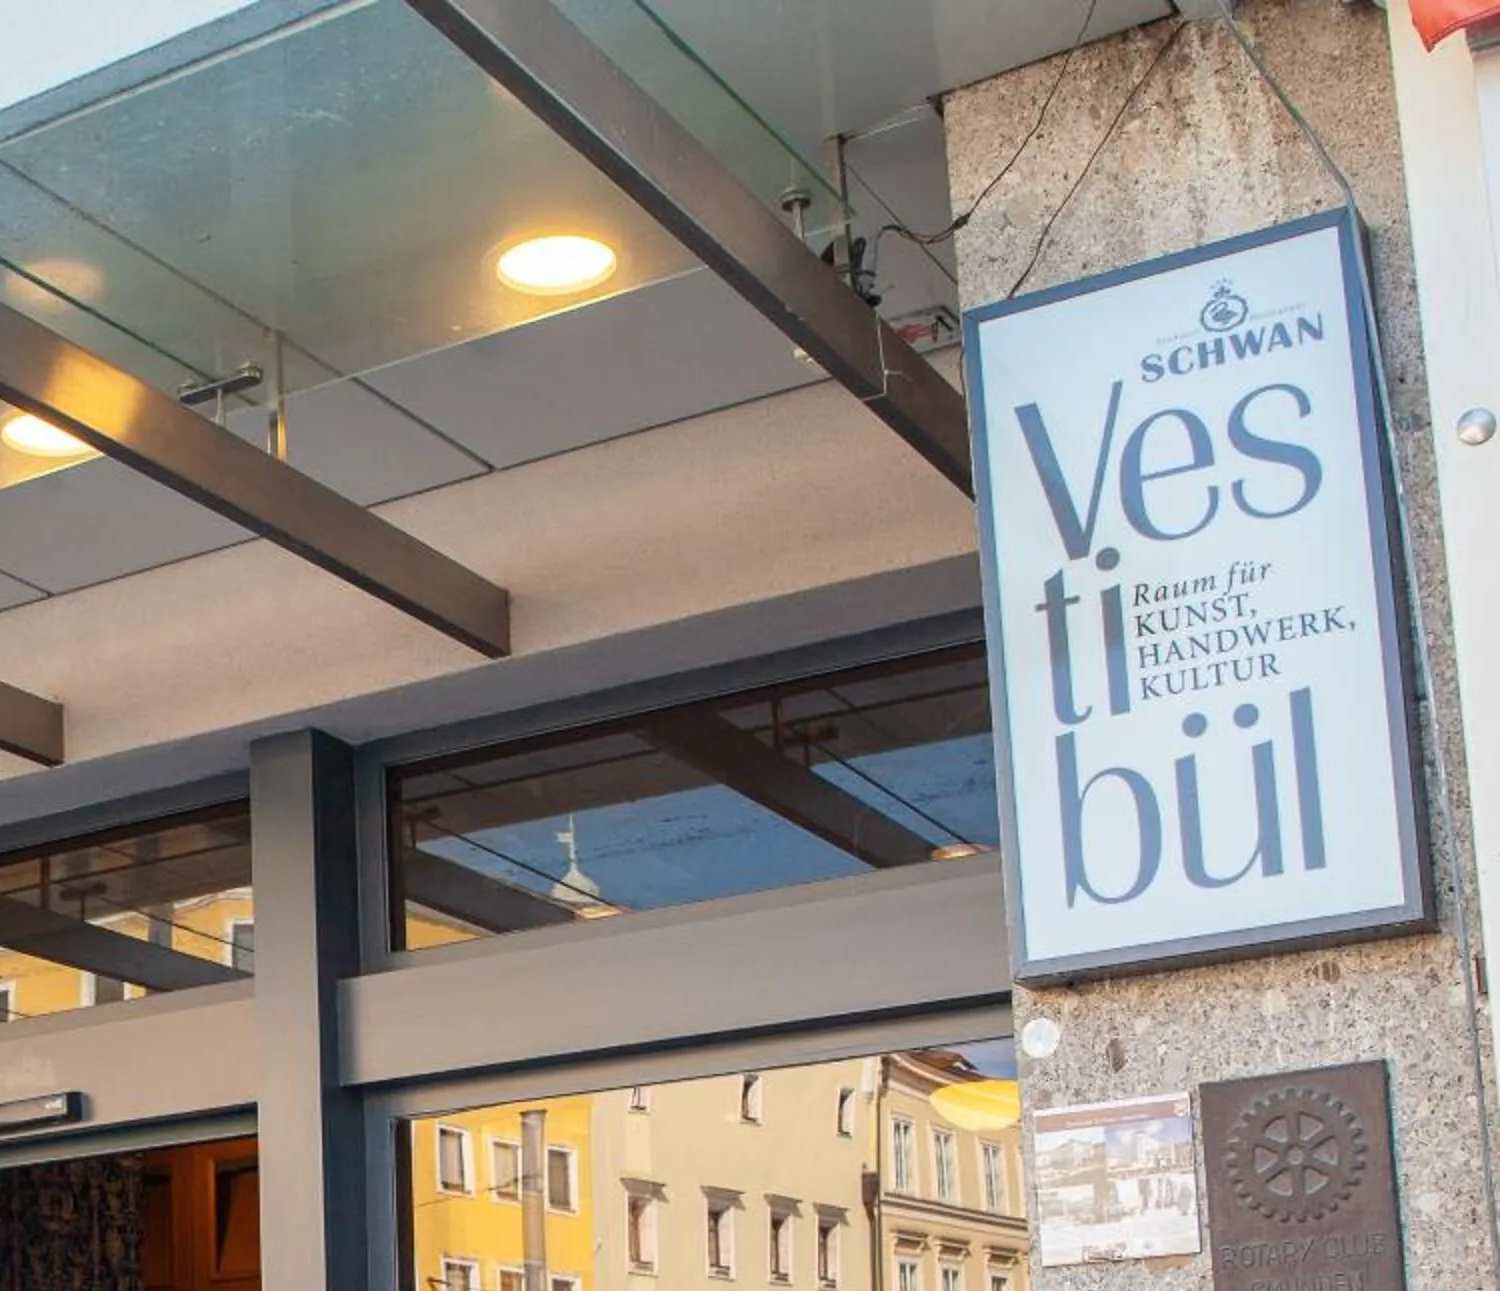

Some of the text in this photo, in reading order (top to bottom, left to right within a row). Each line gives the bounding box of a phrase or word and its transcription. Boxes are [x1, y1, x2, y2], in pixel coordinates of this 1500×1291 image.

[1140, 311, 1324, 384] SCHWAN
[1013, 379, 1324, 562] Ves
[1132, 558, 1273, 607] Raum für
[1034, 546, 1131, 726] ti
[1134, 592, 1258, 638] KUNST,
[1137, 605, 1357, 669] HANDWERK,
[1140, 651, 1283, 700] KULTUR
[1054, 686, 1327, 910] bül
[1219, 1236, 1315, 1270] ROTARY
